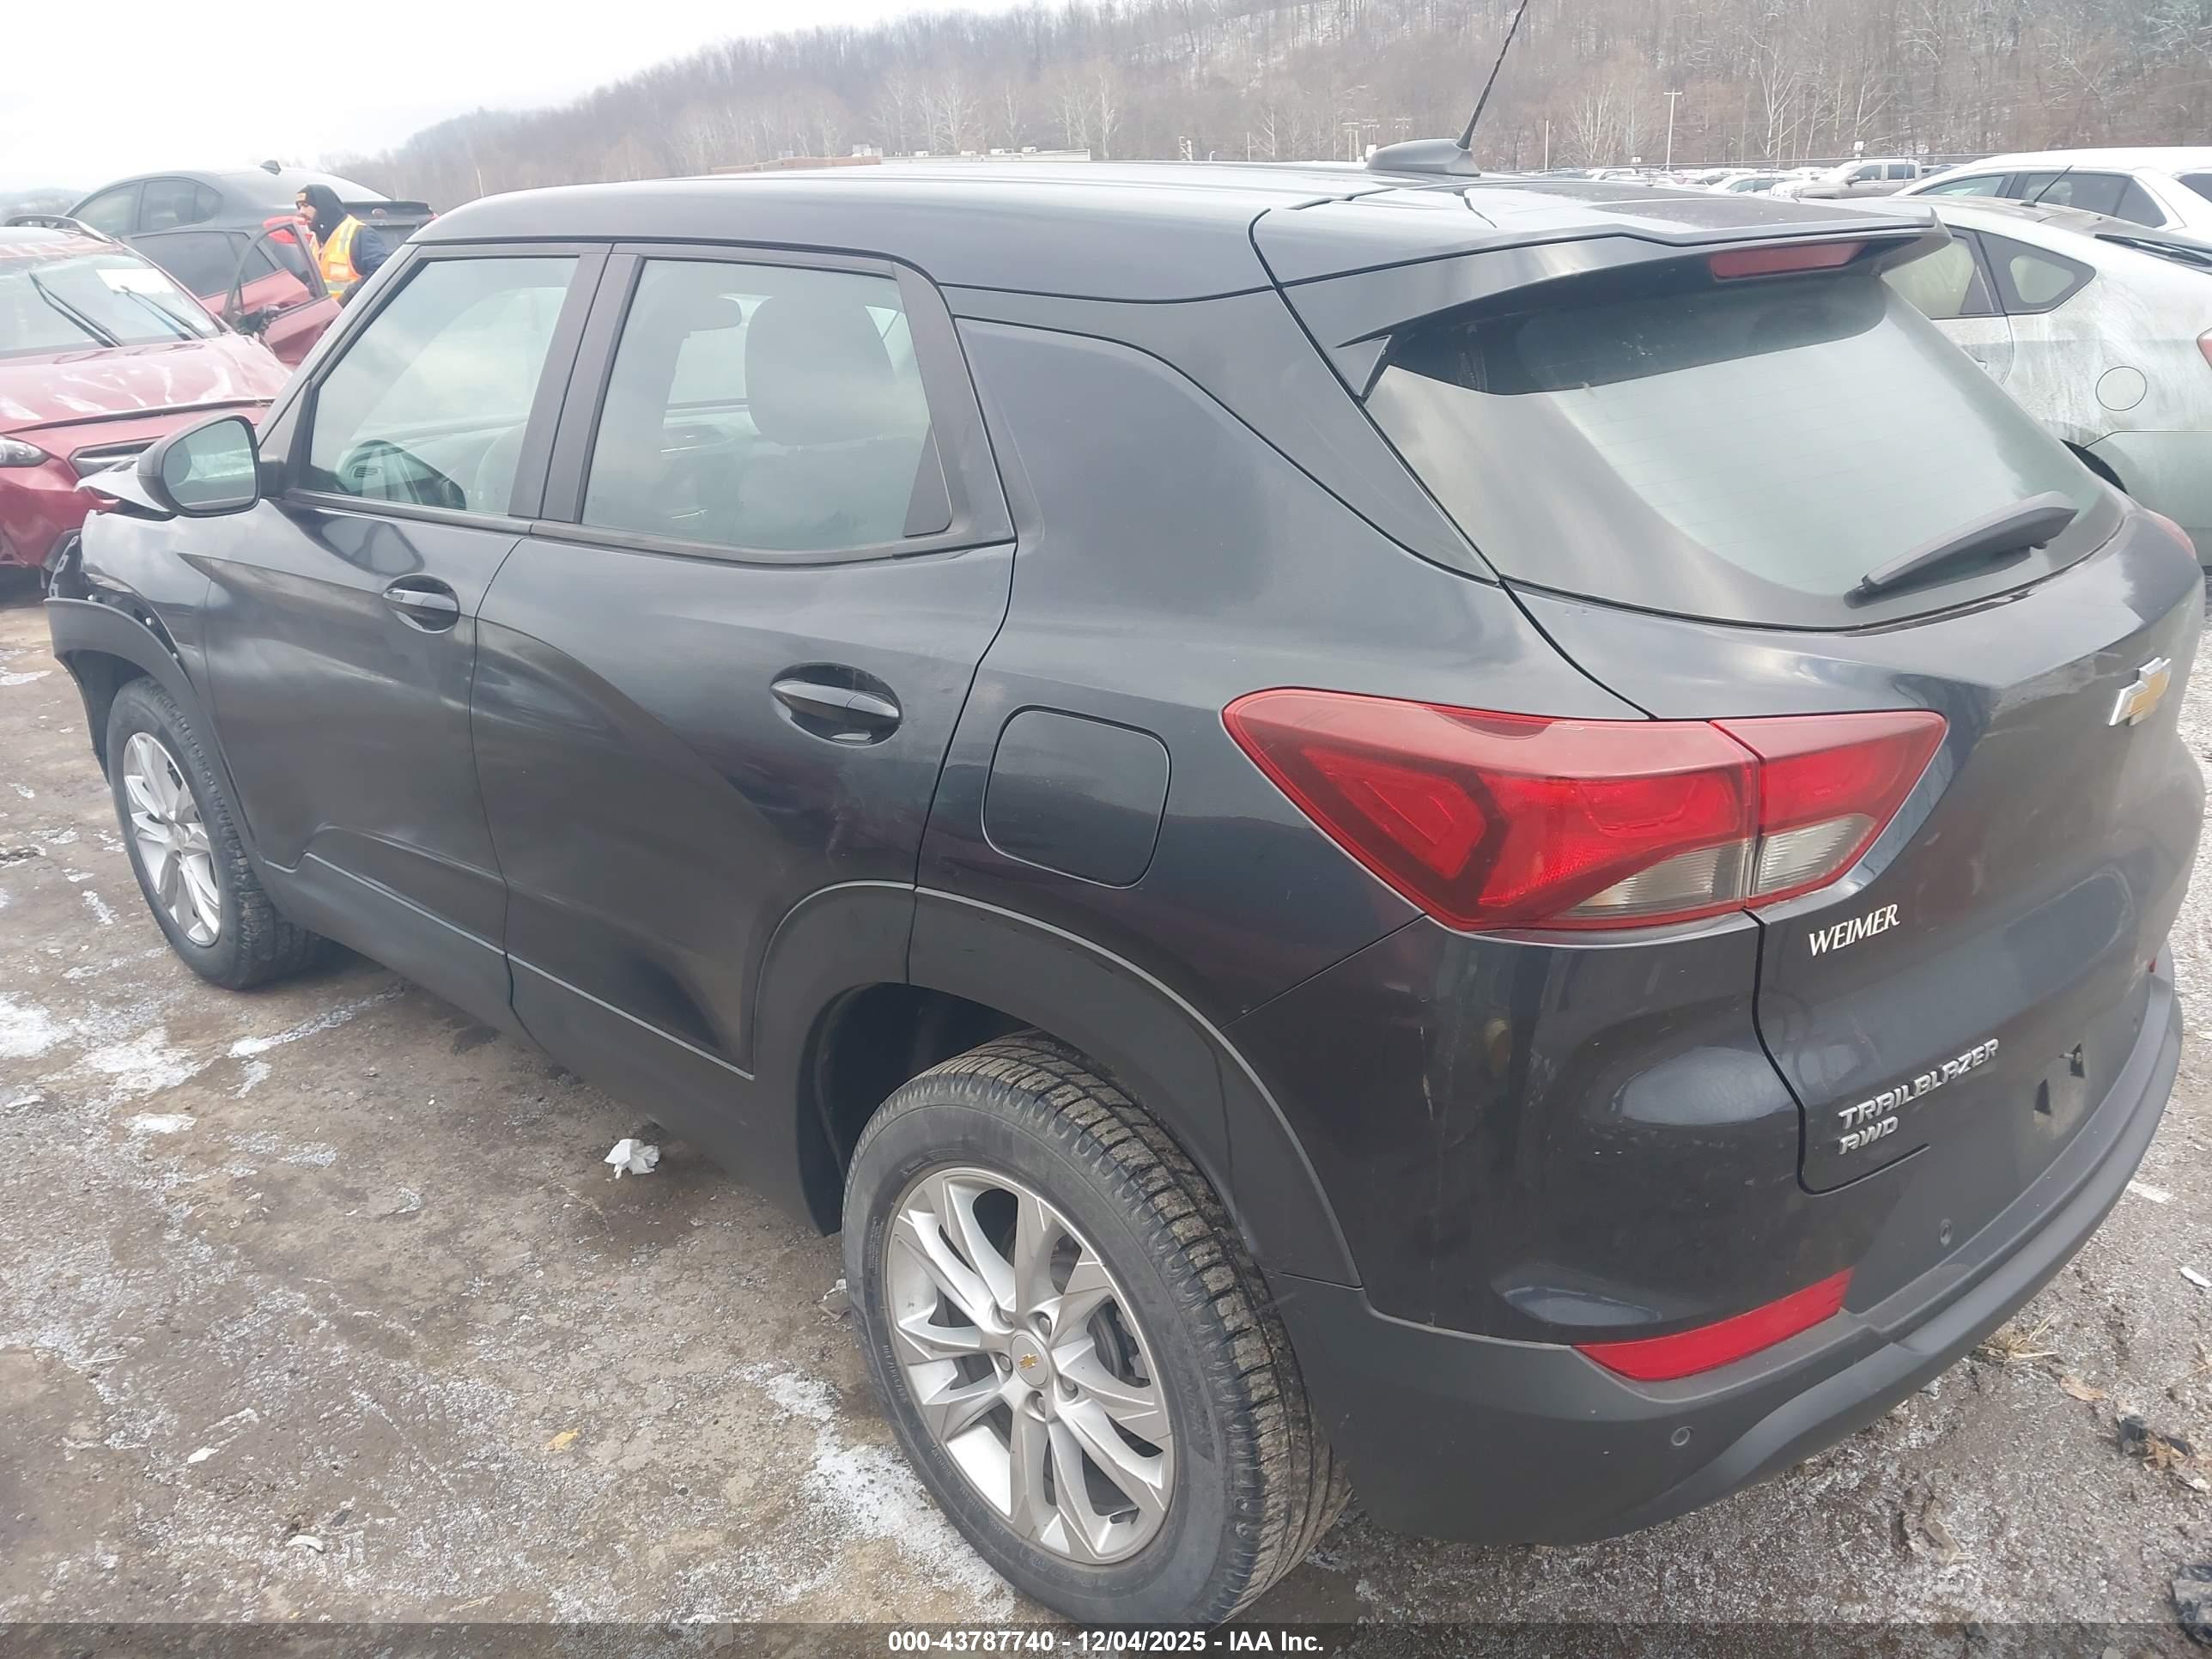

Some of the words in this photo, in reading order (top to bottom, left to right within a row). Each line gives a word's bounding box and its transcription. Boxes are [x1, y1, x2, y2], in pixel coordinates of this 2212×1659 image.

[1808, 903, 1900, 957] WEIMER
[1838, 1037, 2000, 1130] TRAILBLAZER
[1838, 1115, 1899, 1155] AWD
